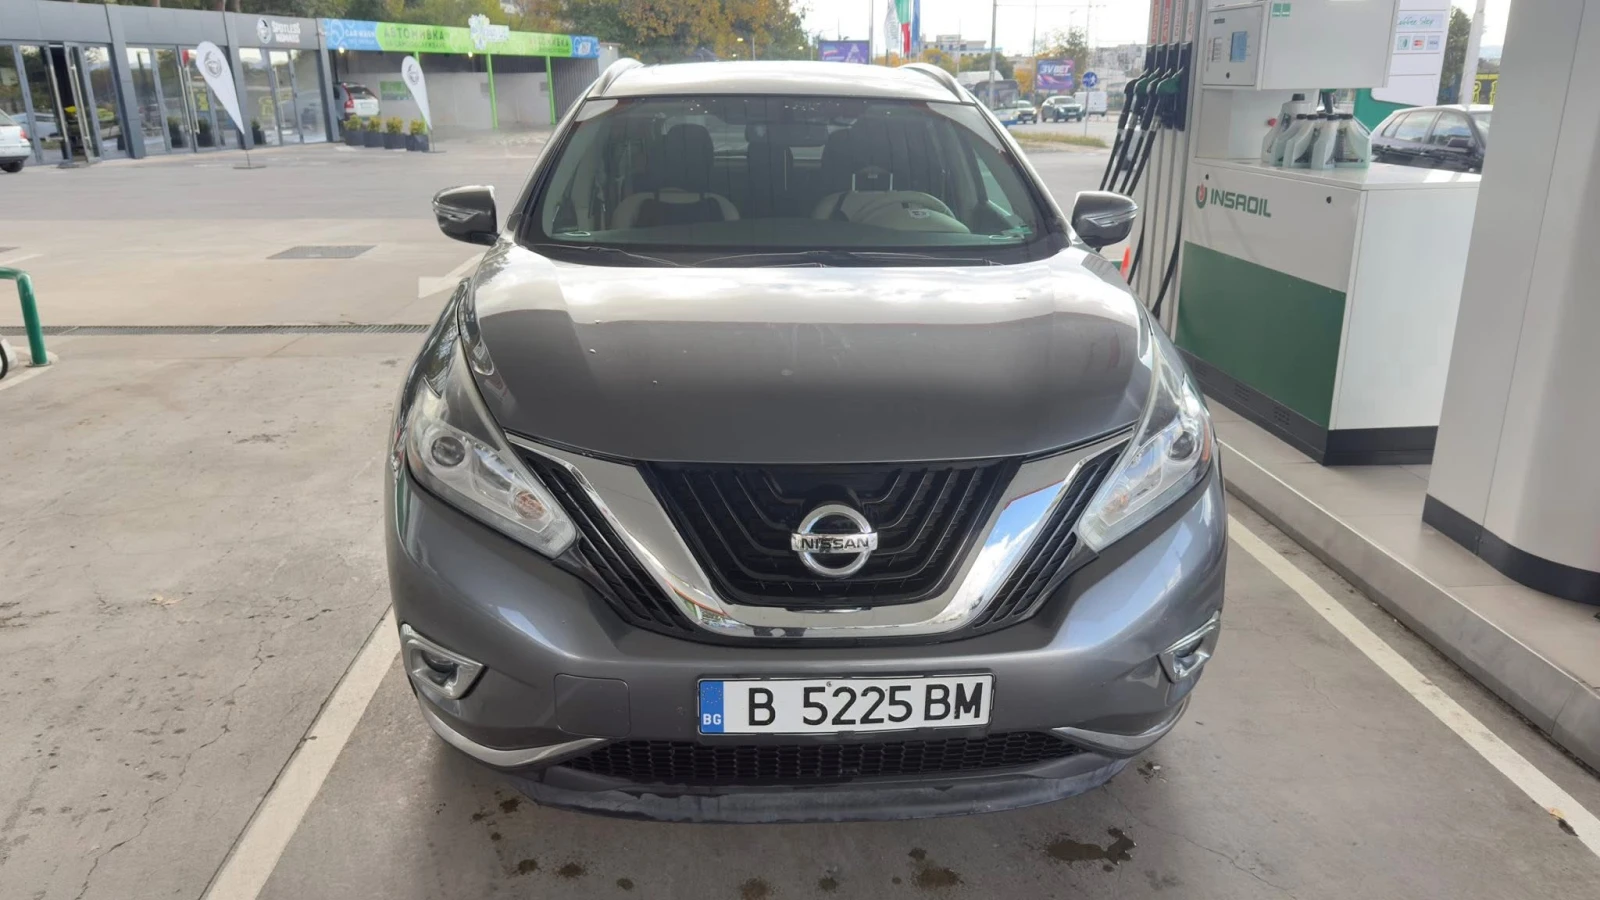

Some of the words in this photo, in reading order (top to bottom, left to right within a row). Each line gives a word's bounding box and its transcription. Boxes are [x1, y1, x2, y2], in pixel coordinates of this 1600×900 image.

[271, 20, 301, 35] SPOTLESS
[1210, 187, 1272, 218] INSAOIL
[801, 537, 869, 549] NISSAN
[748, 687, 776, 726] B
[803, 685, 913, 726] 5225
[924, 682, 984, 721] BM
[703, 713, 722, 725] BG
